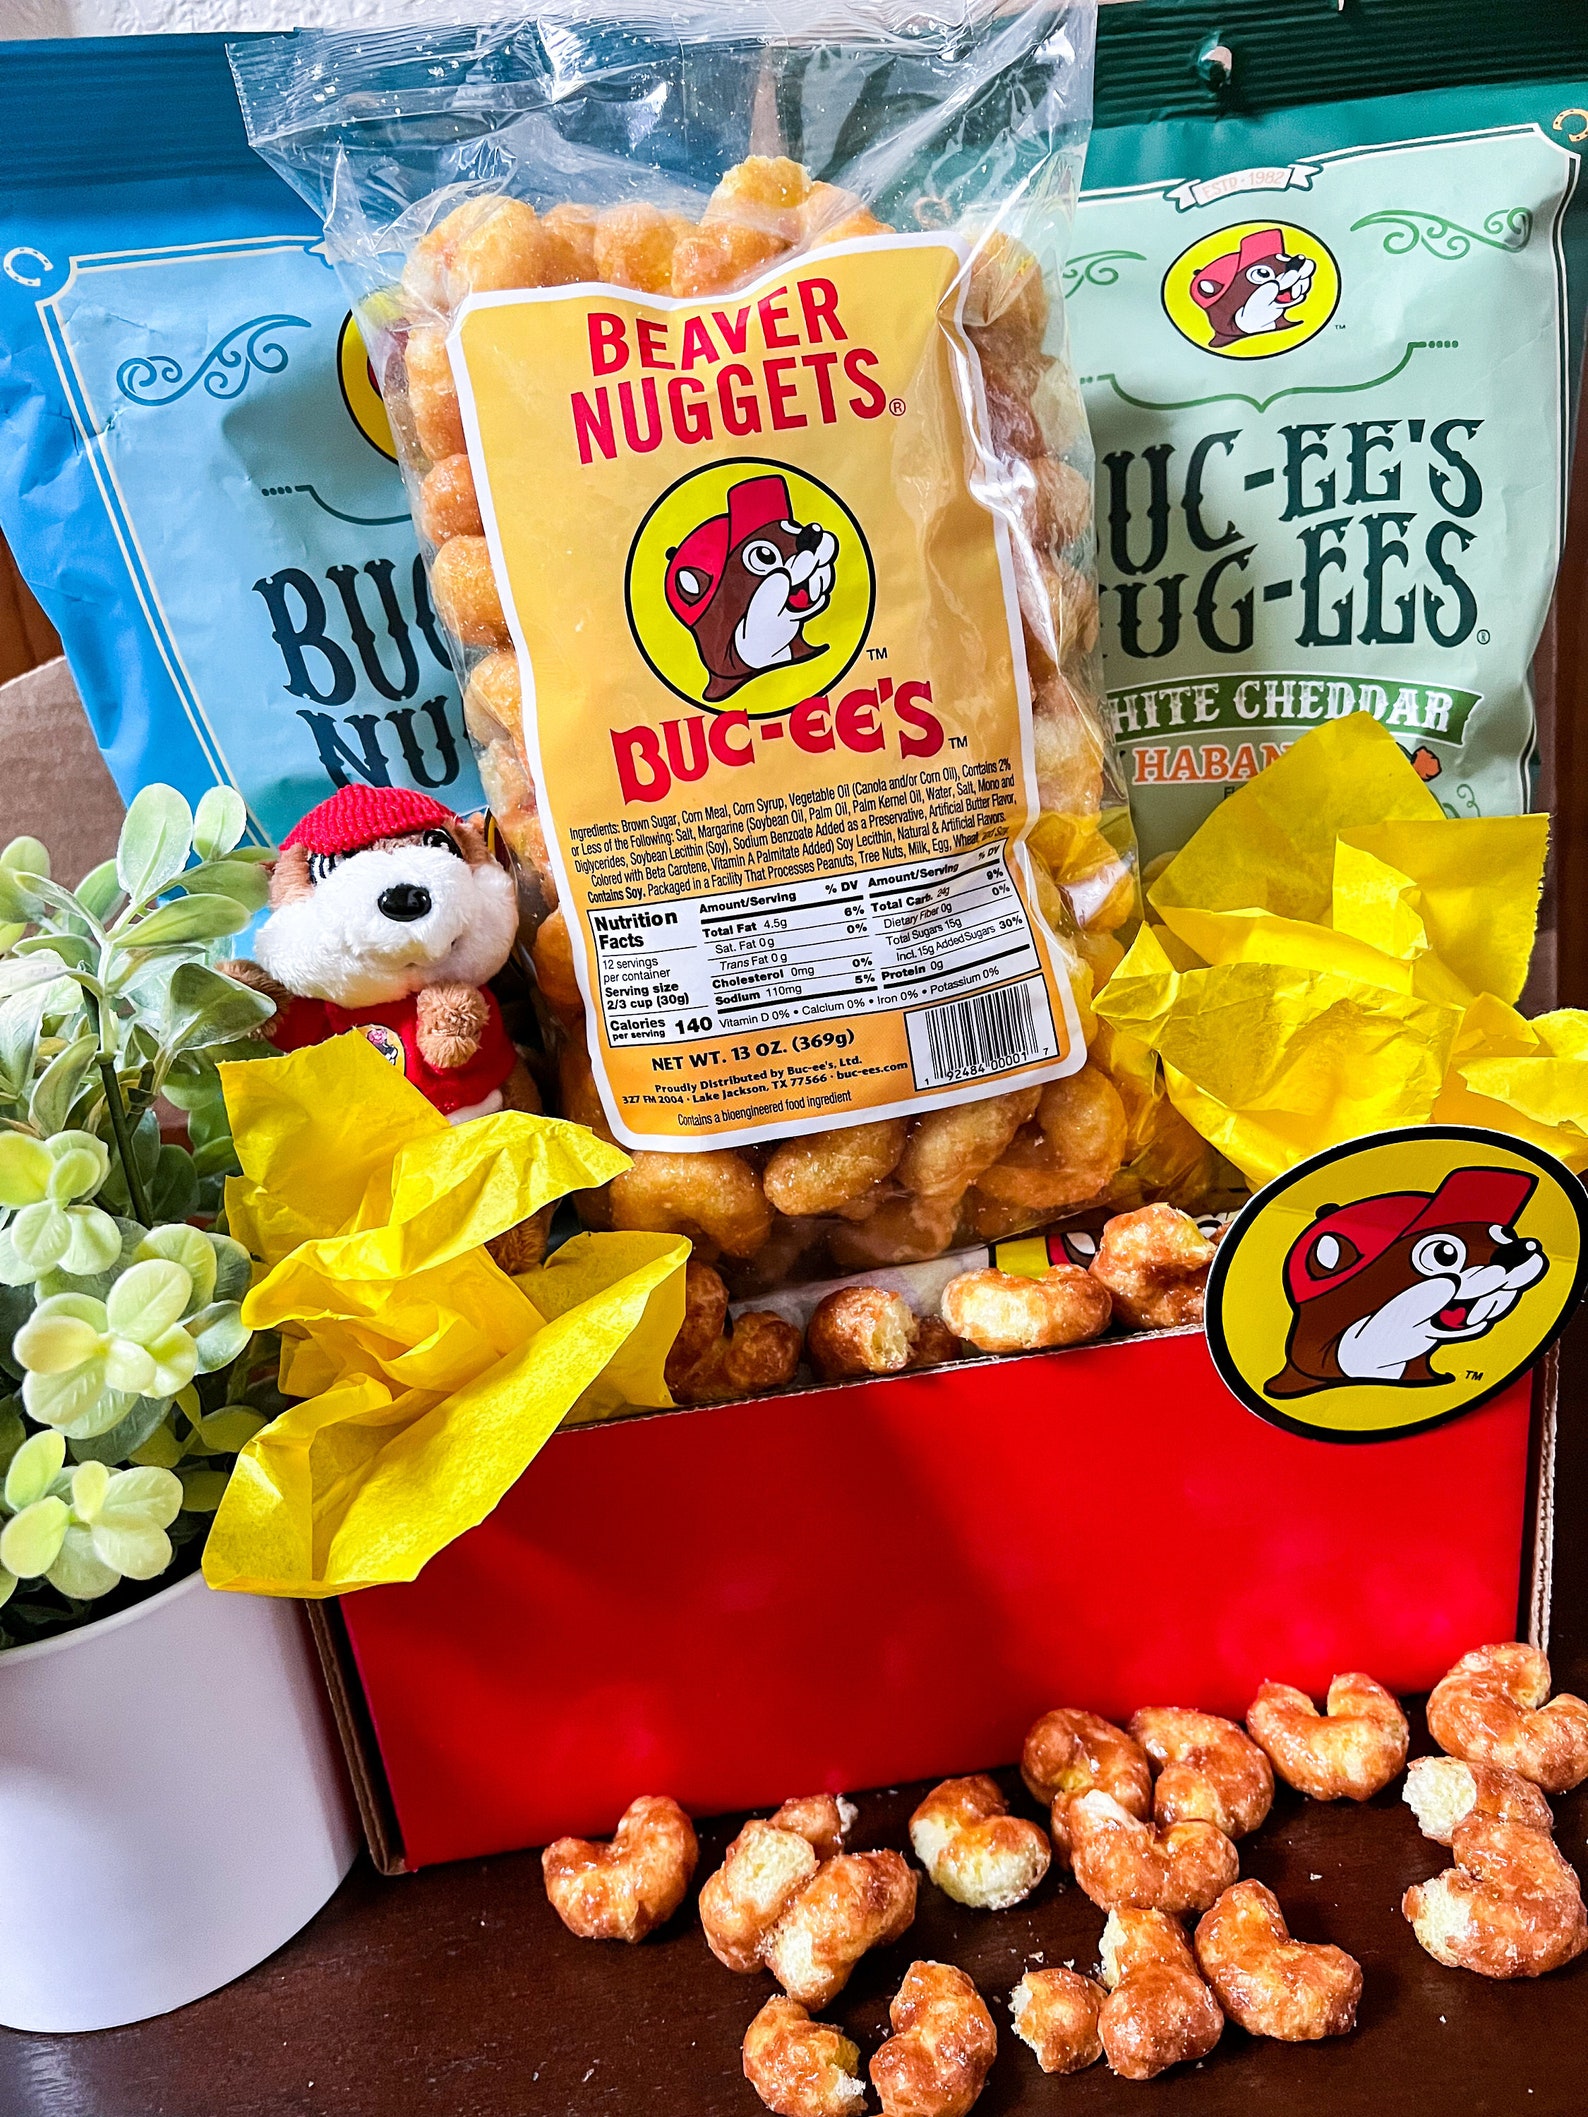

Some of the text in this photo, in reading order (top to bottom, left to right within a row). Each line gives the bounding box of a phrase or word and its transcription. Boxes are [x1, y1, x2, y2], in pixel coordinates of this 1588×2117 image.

[1202, 171, 1285, 199] ESTD 1982
[588, 278, 849, 376] BEAVER
[1097, 420, 1485, 576] UC-EE'S
[866, 648, 888, 661] TM
[1108, 679, 1454, 734] HITE CHEDDAR
[296, 695, 468, 788] NU
[610, 677, 944, 807] BUC-EE'S
[569, 760, 997, 842] Ingredients: Brown Sugar, Corn Meal, Corn Syrup, Vegetable Oil (Canola and/or Corn Oil), Contains
[580, 777, 999, 855] Less the Following: Salt, Margarine (Soybean Oil, Palm Oil, Palm Kernel Oil, Water, Salt, Mono
[574, 792, 1016, 874] Diglycerides, Soybean Lecithin (Soy), Sodium Benzoate Added Preservative, Artificial Butter Flavor,
[590, 814, 975, 887] Colored with Beta Carotene, Vitamin Palmitate Added) Soy Lecithin, Natural Artificial
[587, 837, 952, 903] Contains Soy. Packaged Facility That Processes Peanuts, Tree Nuts, Milk, Egg,
[868, 863, 959, 887] Amount/Serving
[700, 880, 858, 914] Amount/Serving DV
[871, 899, 902, 913] Total
[595, 911, 678, 931] Nutrition
[703, 906, 864, 938] Total Fat 4.5g 6%
[884, 912, 917, 928] Dietary
[887, 918, 962, 946] Total Sugars 15g
[600, 934, 644, 950] Facts
[715, 924, 868, 954] Sat. Fat 0%
[918, 917, 1023, 956] 15g 30%
[603, 957, 658, 969] 12 servings
[604, 969, 670, 984] per container
[713, 958, 873, 989] Cholesterol 0mg 0%
[720, 956, 768, 971] Trans Fat
[882, 960, 943, 981] Protein 0g
[605, 982, 679, 997] Serving size
[607, 992, 689, 1011] 2/3 cup (30g)
[716, 974, 875, 1005] Sodium 110mg 5%
[719, 974, 981, 1029] Vitamin Calcium Iron Potassium
[610, 1016, 712, 1035] Calories 140
[613, 1029, 665, 1041] per serving
[652, 1028, 855, 1071] NET WT. 13 OZ. (369g)
[655, 1056, 862, 1094] Proudly Distributed by Buc-ee's, Ltd.
[947, 1051, 1028, 1081] 92484 00001
[623, 1096, 640, 1104] 327
[658, 1096, 684, 1104] 2004
[693, 1092, 719, 1103] Lake
[722, 1083, 769, 1101] Jackson,
[772, 1080, 787, 1090] TX
[791, 1074, 827, 1087] 77566
[836, 1060, 908, 1078] buc-ees.com
[678, 1090, 851, 1126] Contains bioengineered food ingredient
